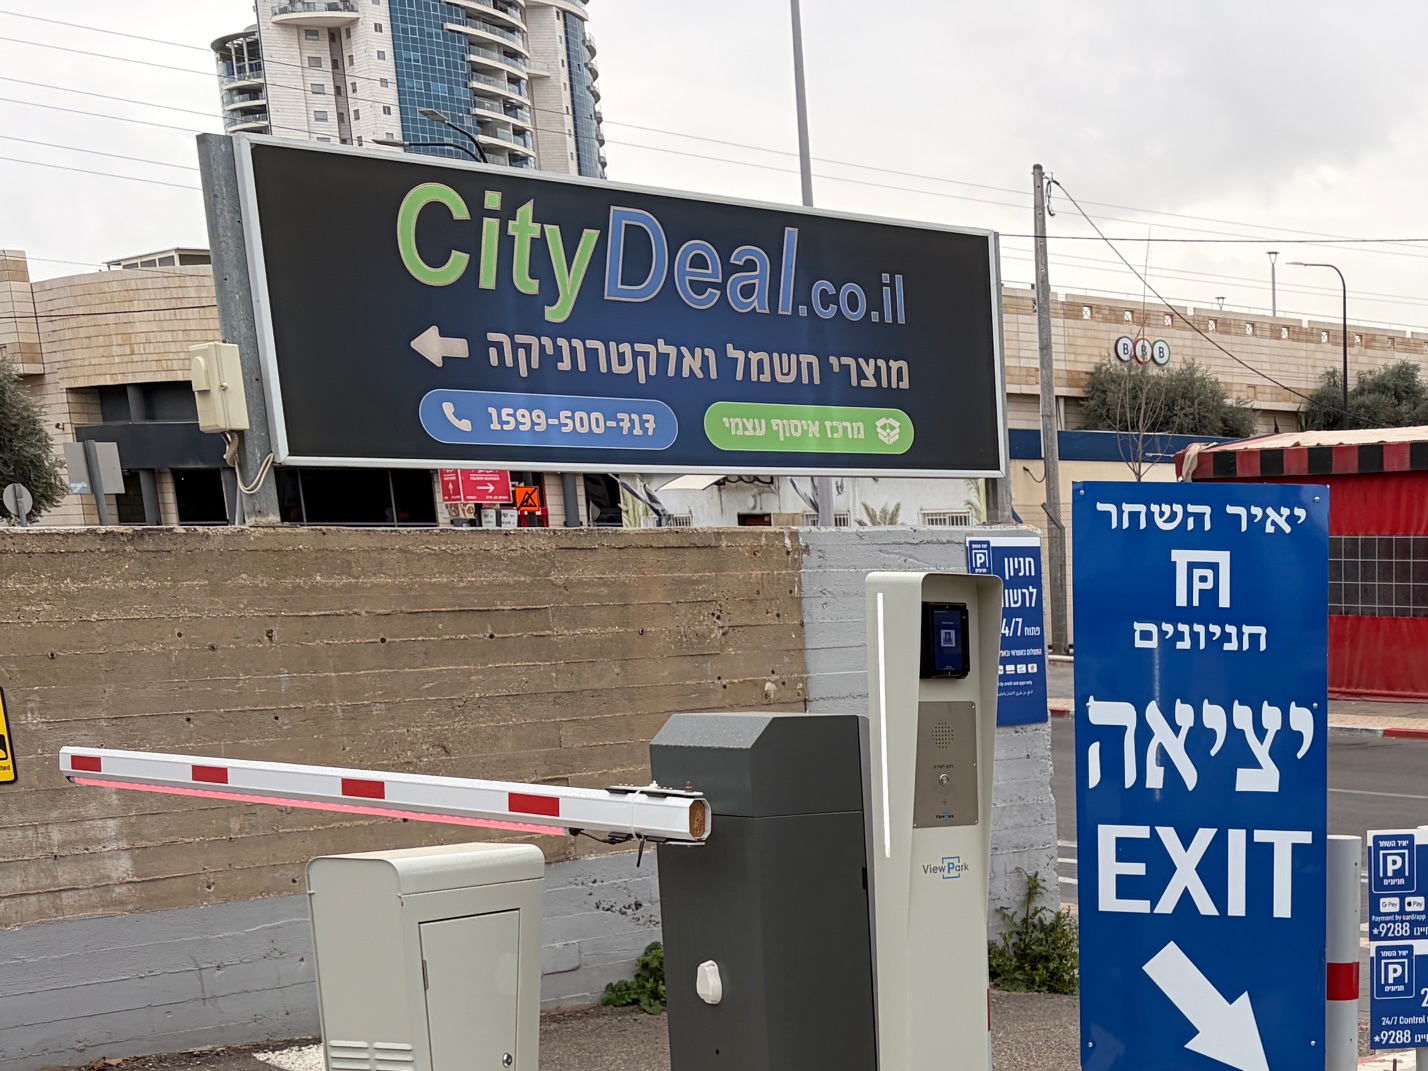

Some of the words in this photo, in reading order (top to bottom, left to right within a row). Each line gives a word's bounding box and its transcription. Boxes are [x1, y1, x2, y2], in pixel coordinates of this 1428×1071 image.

[397, 182, 906, 324] CityDeal.co.il
[486, 332, 717, 384] ואלקטרוניקה
[726, 343, 820, 385] חשמל
[829, 356, 910, 390] מוצרי
[487, 406, 656, 436] 1599-500-717
[722, 416, 767, 437] עצמי
[771, 417, 820, 442] איסוף
[824, 419, 865, 439] מרכז
[1096, 501, 1212, 531] השחר
[1225, 504, 1307, 534] יאיר
[1004, 557, 1035, 580] חניון
[1002, 585, 1037, 608] לרשו
[1000, 617, 1023, 637] 4/7
[1024, 626, 1041, 636] פתוח
[1133, 621, 1267, 652] חניונים
[1087, 695, 1314, 793] יציאה
[922, 861, 970, 875] ViewPark
[1097, 824, 1313, 919] EXIT
[1386, 855, 1403, 877] P
[1413, 900, 1423, 909] Pay
[1387, 963, 1403, 984] P
[1381, 1016, 1398, 1026] 24/7
[1399, 1014, 1426, 1024] Control
